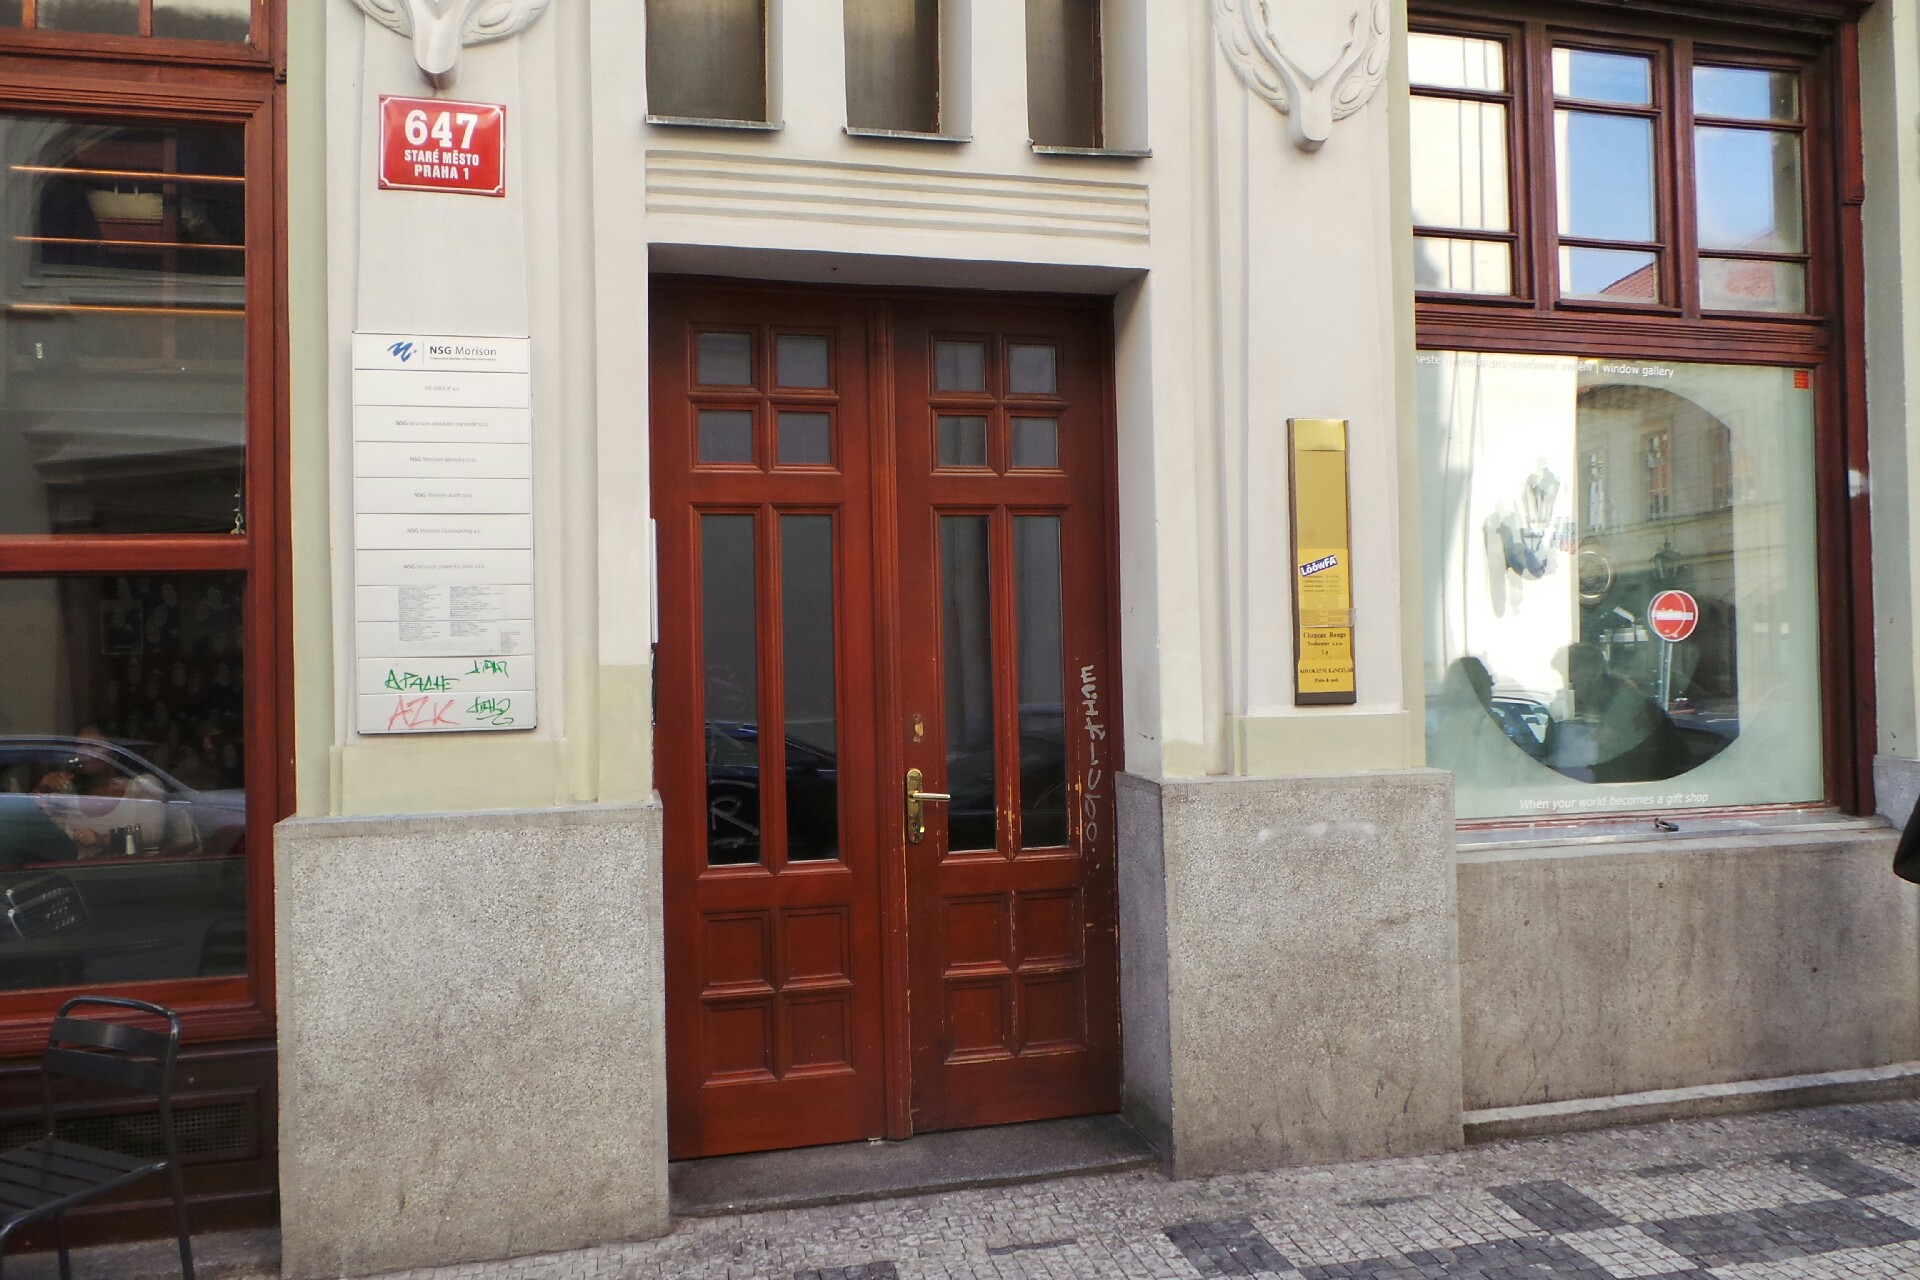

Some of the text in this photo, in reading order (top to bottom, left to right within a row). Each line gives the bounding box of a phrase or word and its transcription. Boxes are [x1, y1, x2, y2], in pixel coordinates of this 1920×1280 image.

[404, 109, 479, 149] 647
[404, 149, 480, 166] STARÉ MĚSTO
[414, 164, 470, 180] PRAHA 1
[429, 346, 497, 356] NSG Morison
[1602, 364, 1640, 374] window
[1642, 366, 1674, 378] gallery
[1519, 799, 1549, 809] When
[1552, 800, 1577, 811] your
[1579, 797, 1606, 807] world
[1609, 795, 1655, 806] becomes
[1666, 793, 1684, 806] gift
[1685, 792, 1709, 804] shop
